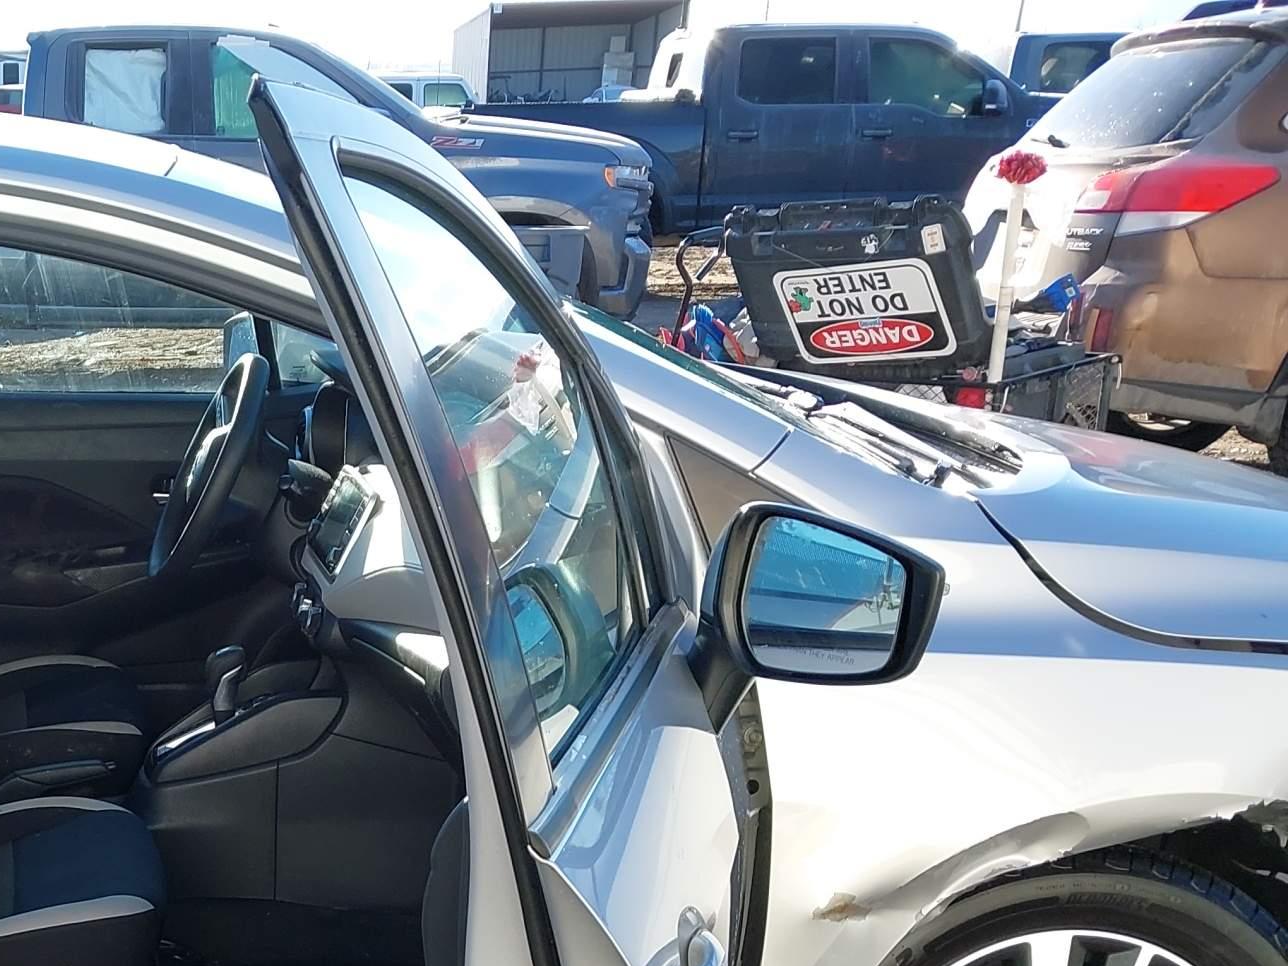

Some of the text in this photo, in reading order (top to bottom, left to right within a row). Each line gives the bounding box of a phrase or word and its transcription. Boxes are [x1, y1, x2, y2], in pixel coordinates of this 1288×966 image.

[431, 136, 485, 149] Z71
[1064, 227, 1104, 236] UTBACK
[815, 271, 891, 295] ENTER
[817, 292, 909, 318] DO NOT
[824, 324, 921, 349] DANGER
